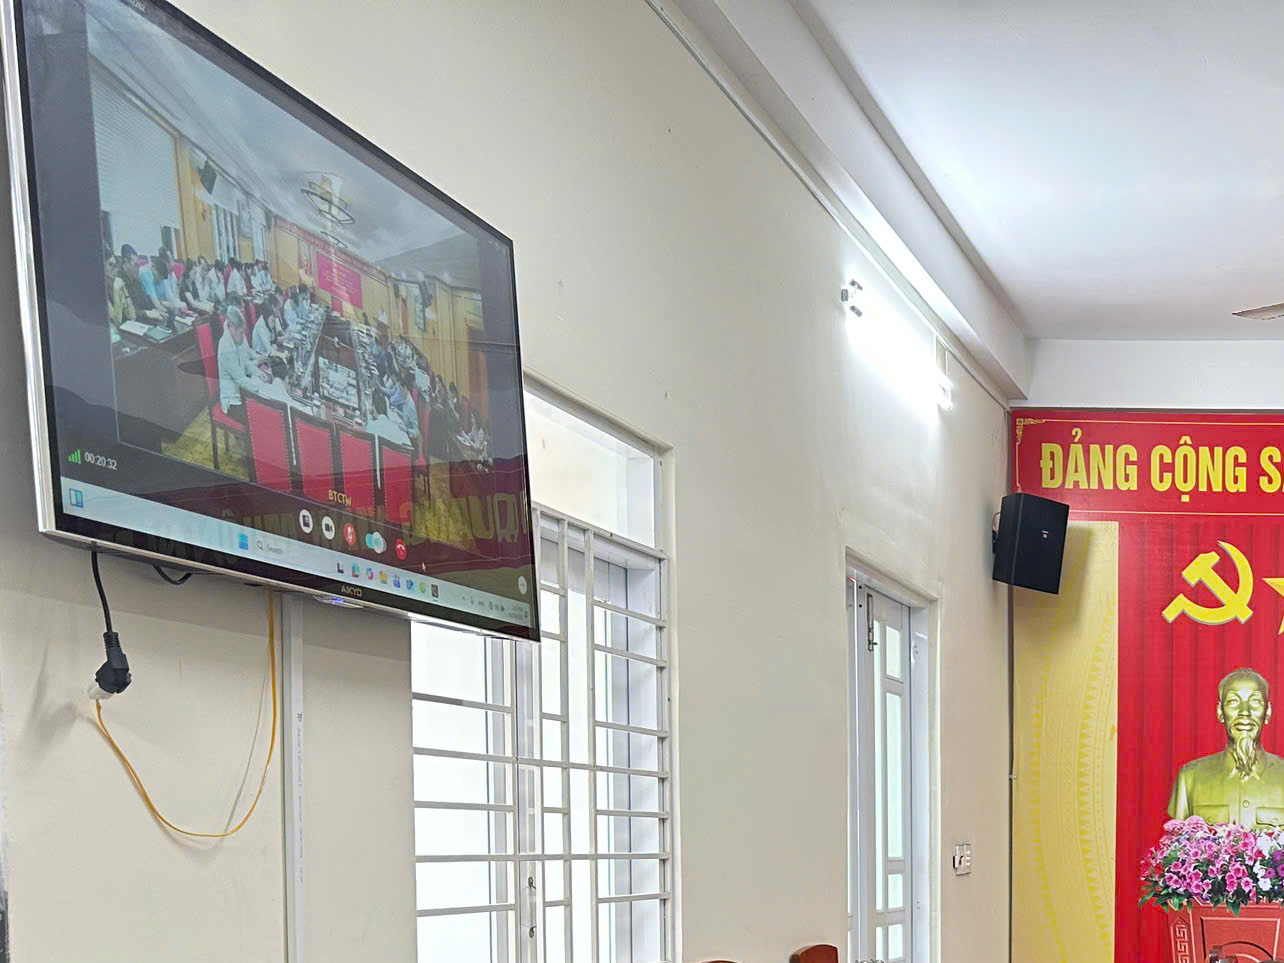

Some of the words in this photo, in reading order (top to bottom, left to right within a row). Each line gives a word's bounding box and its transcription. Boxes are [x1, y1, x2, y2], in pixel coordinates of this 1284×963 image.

[84, 451, 118, 470] 00:20:32
[1039, 428, 1139, 492] ĐẢNG
[1150, 435, 1248, 503] CỘNG
